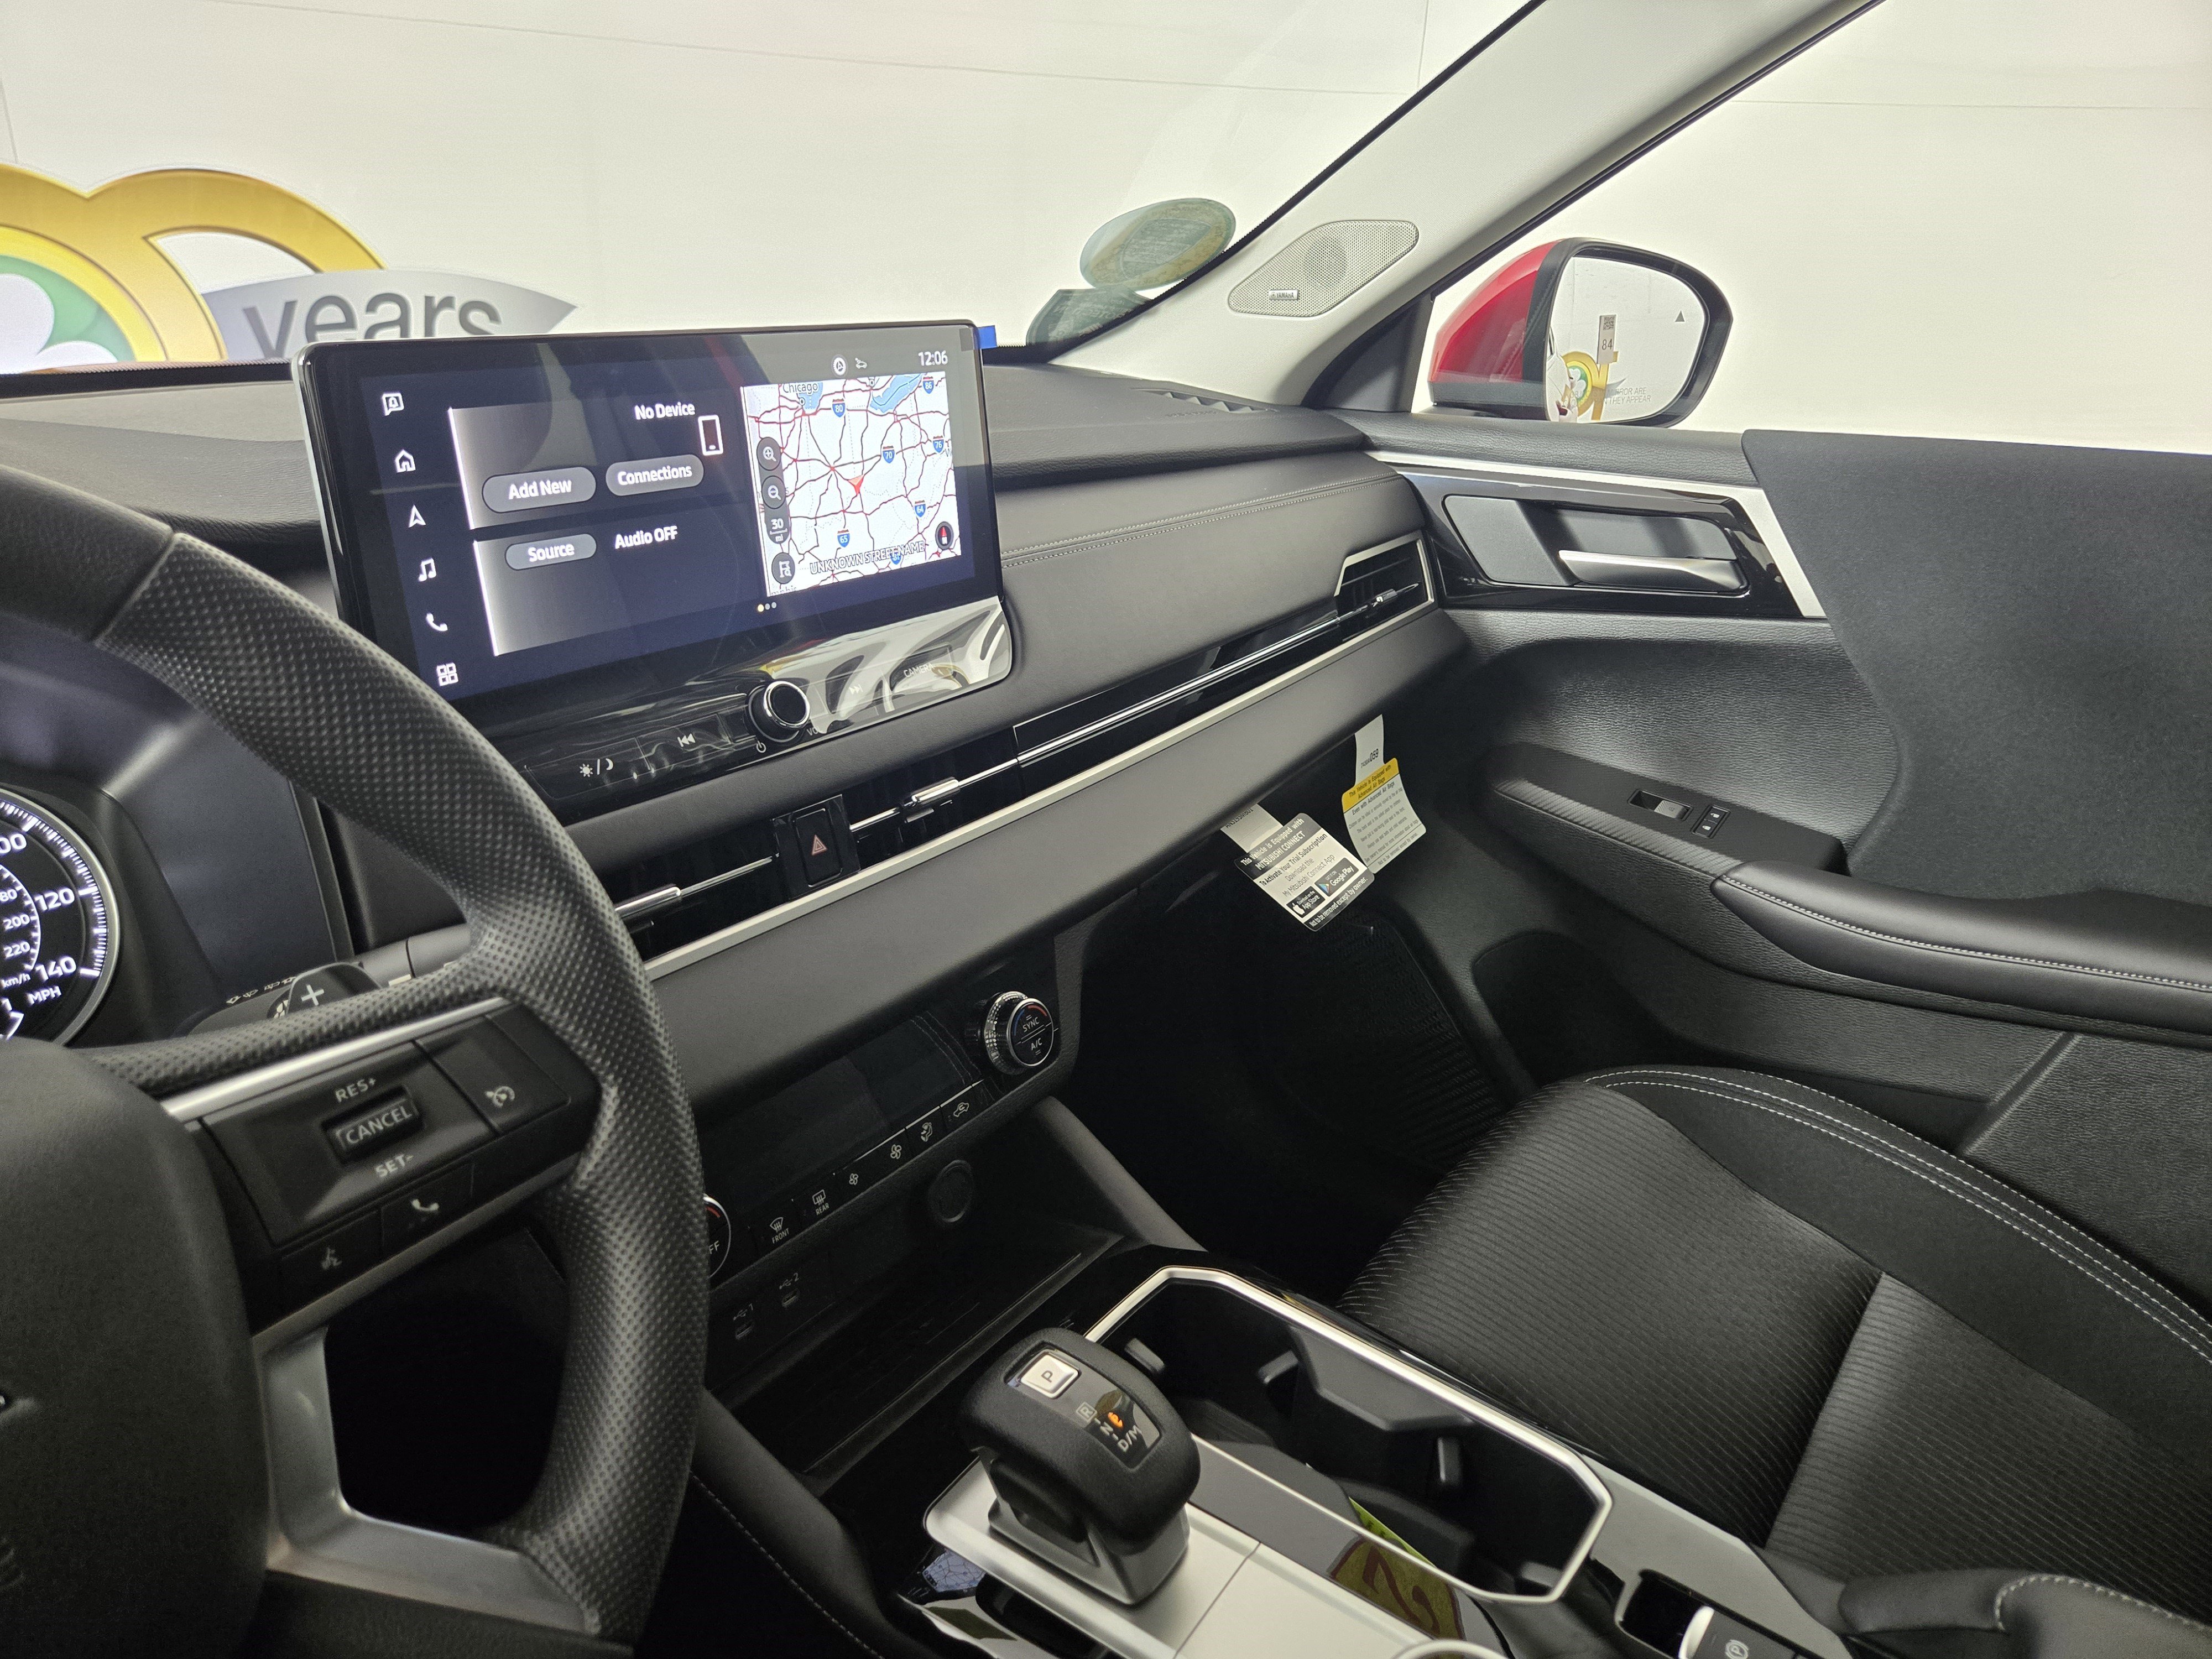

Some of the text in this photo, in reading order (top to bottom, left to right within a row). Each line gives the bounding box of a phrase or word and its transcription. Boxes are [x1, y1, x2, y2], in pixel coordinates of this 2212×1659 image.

[1601, 338, 1613, 351] 84
[918, 350, 948, 366] 12:06
[782, 383, 818, 394] Chicago
[834, 404, 843, 413] 80
[1627, 395, 1651, 404] APPEAR
[634, 401, 695, 420] No Device
[885, 451, 893, 459] 70
[617, 465, 692, 486] Connections
[509, 478, 572, 499] Add New
[771, 518, 784, 530] 30
[614, 525, 678, 549] Audio OFF
[775, 534, 784, 542] mi
[839, 535, 848, 544] 65
[528, 542, 575, 562] Source
[810, 540, 925, 575] UNKNOWN STREET NAME
[903, 663, 935, 678] CAMERA
[1357, 781, 1367, 791] Vehicle
[1371, 769, 1385, 781] Equipped
[1358, 786, 1371, 799] Advanced
[1352, 805, 1360, 815] Even
[1368, 790, 1381, 804] Advanced
[0, 833, 27, 853] 00
[1240, 856, 1252, 866] This
[1249, 846, 1267, 859] Vehicle
[1270, 826, 1292, 844] Equipped
[1291, 817, 1304, 829] with
[1255, 831, 1305, 870] MITSUBISHI CONNECT
[1263, 868, 1281, 883] Activate
[1279, 862, 1291, 872] Your
[1288, 854, 1301, 864] Trial
[1298, 833, 1328, 857] Subscription
[1285, 857, 1314, 881] Download the
[1287, 874, 1310, 892] Mitsubishi
[1306, 861, 1327, 878] Connect
[1323, 853, 1335, 864] App
[1329, 865, 1354, 886] Google Play
[0, 888, 75, 911] 80 120
[1296, 895, 1308, 905] Download
[1301, 894, 1320, 910] App Store
[1322, 901, 1339, 916] removed
[1336, 893, 1349, 905] except
[1353, 877, 1368, 890] owner.
[3, 914, 30, 930] 200
[3, 941, 77, 982] 220 140
[1, 972, 31, 989] km/h
[27, 985, 62, 1005] MPH
[1022, 1016, 1040, 1032] SYNC
[1031, 1037, 1042, 1051] A/C
[335, 1078, 377, 1103] RES+
[346, 1106, 413, 1144] CANCEL
[816, 1202, 830, 1215] REAR
[771, 1228, 790, 1244] FRONT
[708, 1240, 720, 1255] FF
[1041, 1370, 1054, 1383] P
[1080, 1405, 1094, 1418] R
[1117, 1425, 1142, 1453] D/M
